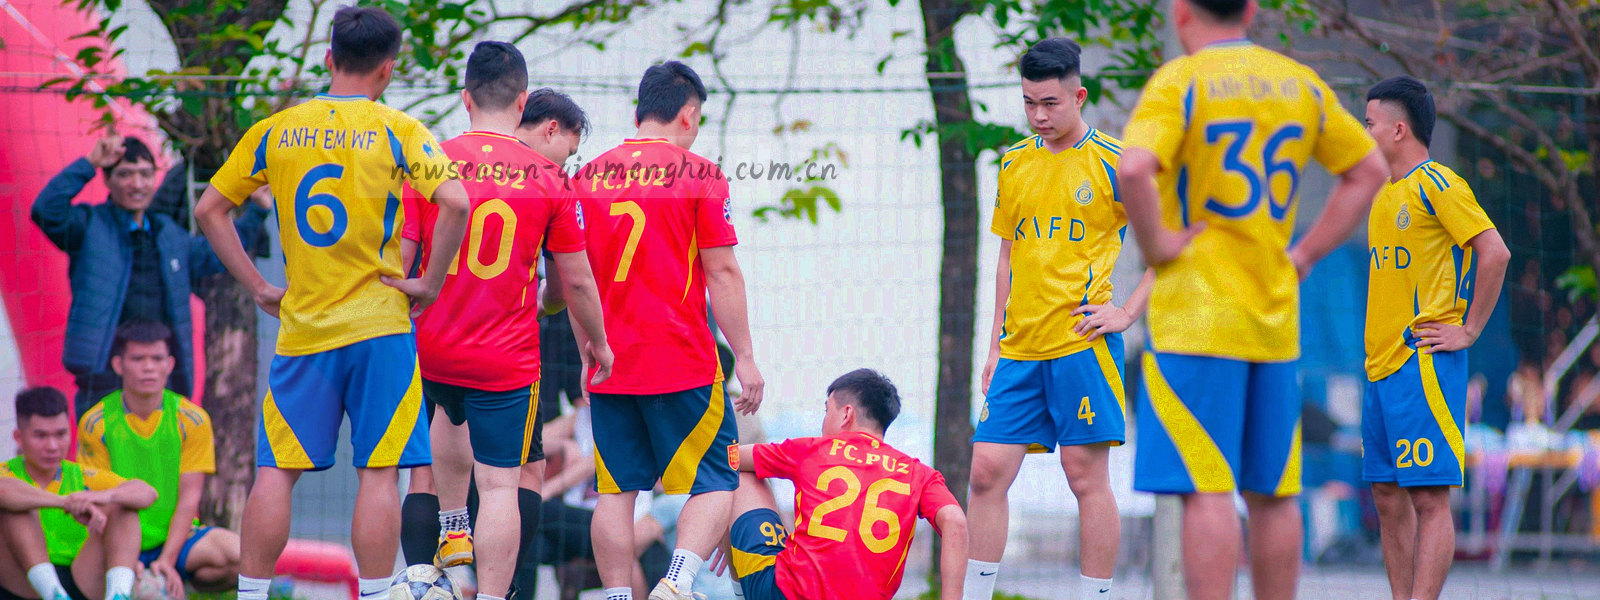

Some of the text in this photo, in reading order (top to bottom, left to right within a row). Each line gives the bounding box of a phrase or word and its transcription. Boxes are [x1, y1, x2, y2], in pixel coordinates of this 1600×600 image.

[278, 127, 377, 150] ANH EM WF
[1204, 119, 1304, 221] 36
[294, 163, 348, 247] 6
[609, 200, 646, 282] 7
[1077, 396, 1096, 425] 4
[1396, 437, 1434, 469] 20
[807, 465, 911, 554] 26
